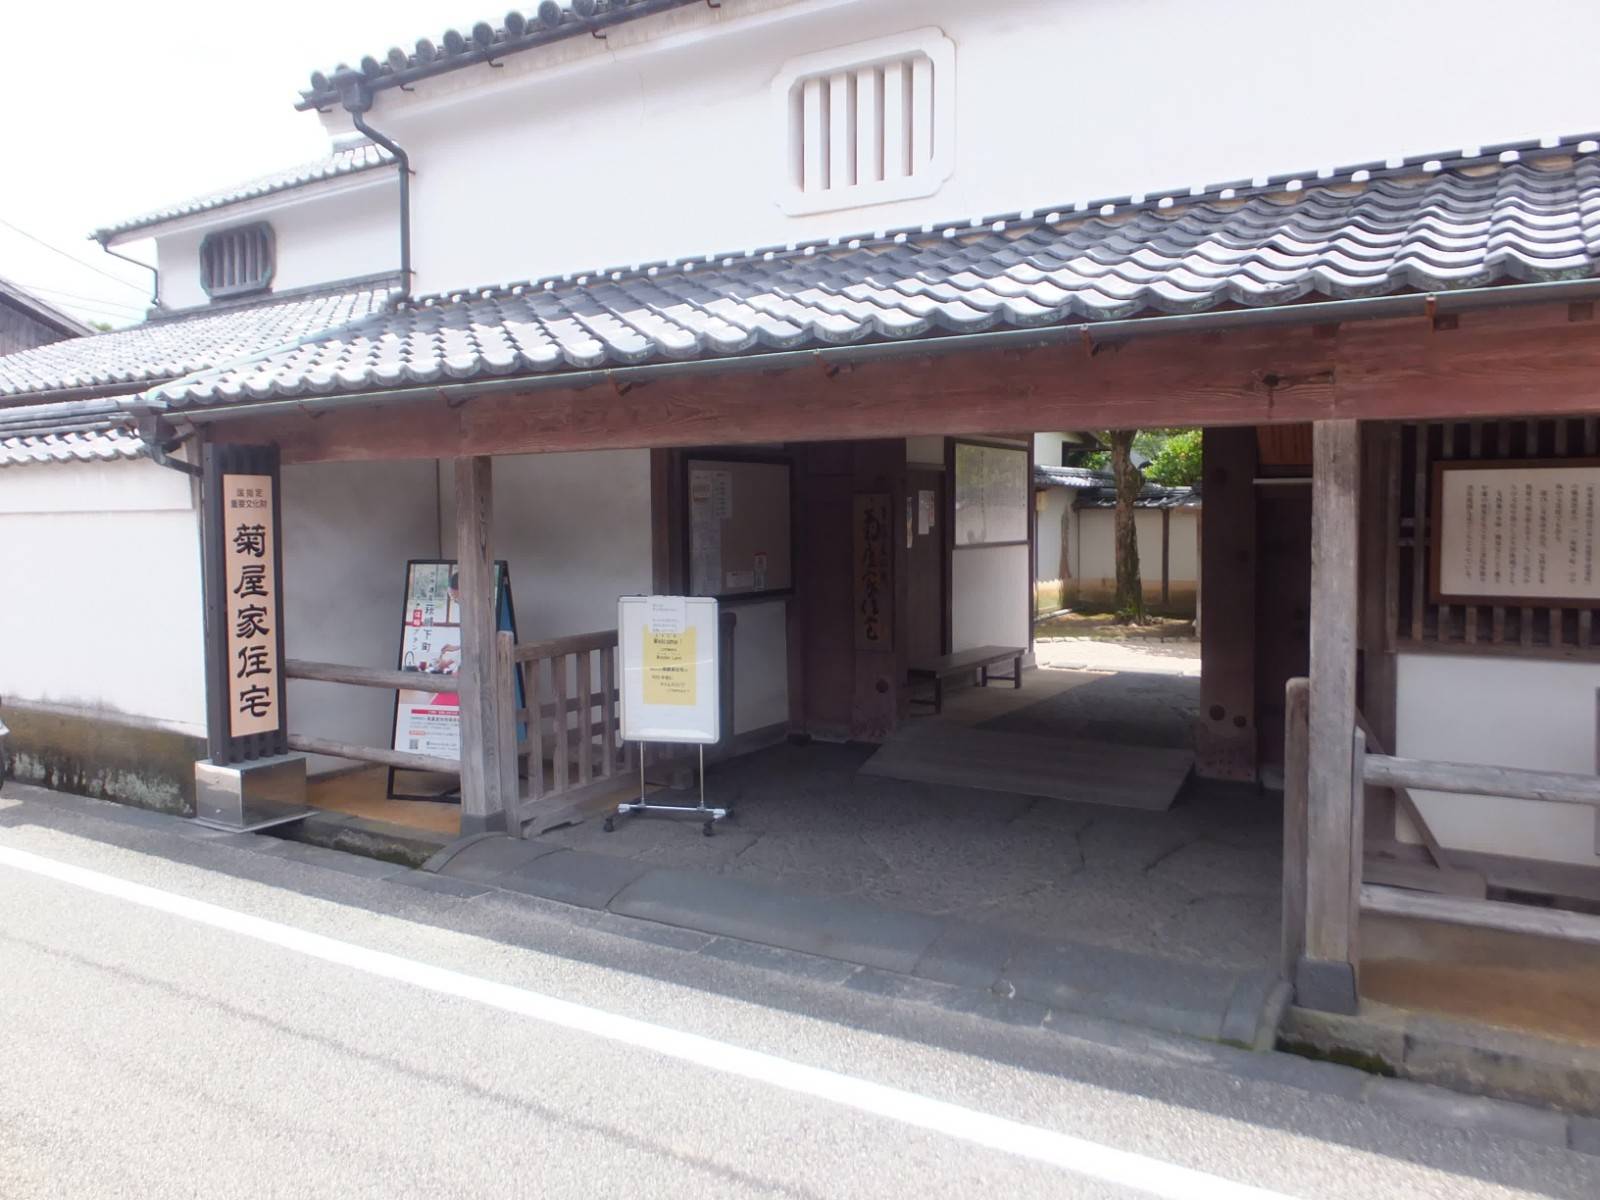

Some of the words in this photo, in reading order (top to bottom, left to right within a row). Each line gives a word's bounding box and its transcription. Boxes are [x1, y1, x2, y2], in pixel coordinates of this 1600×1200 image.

[231, 499, 268, 509] 重要文化財
[233, 524, 272, 717] 菊屋家住宅
